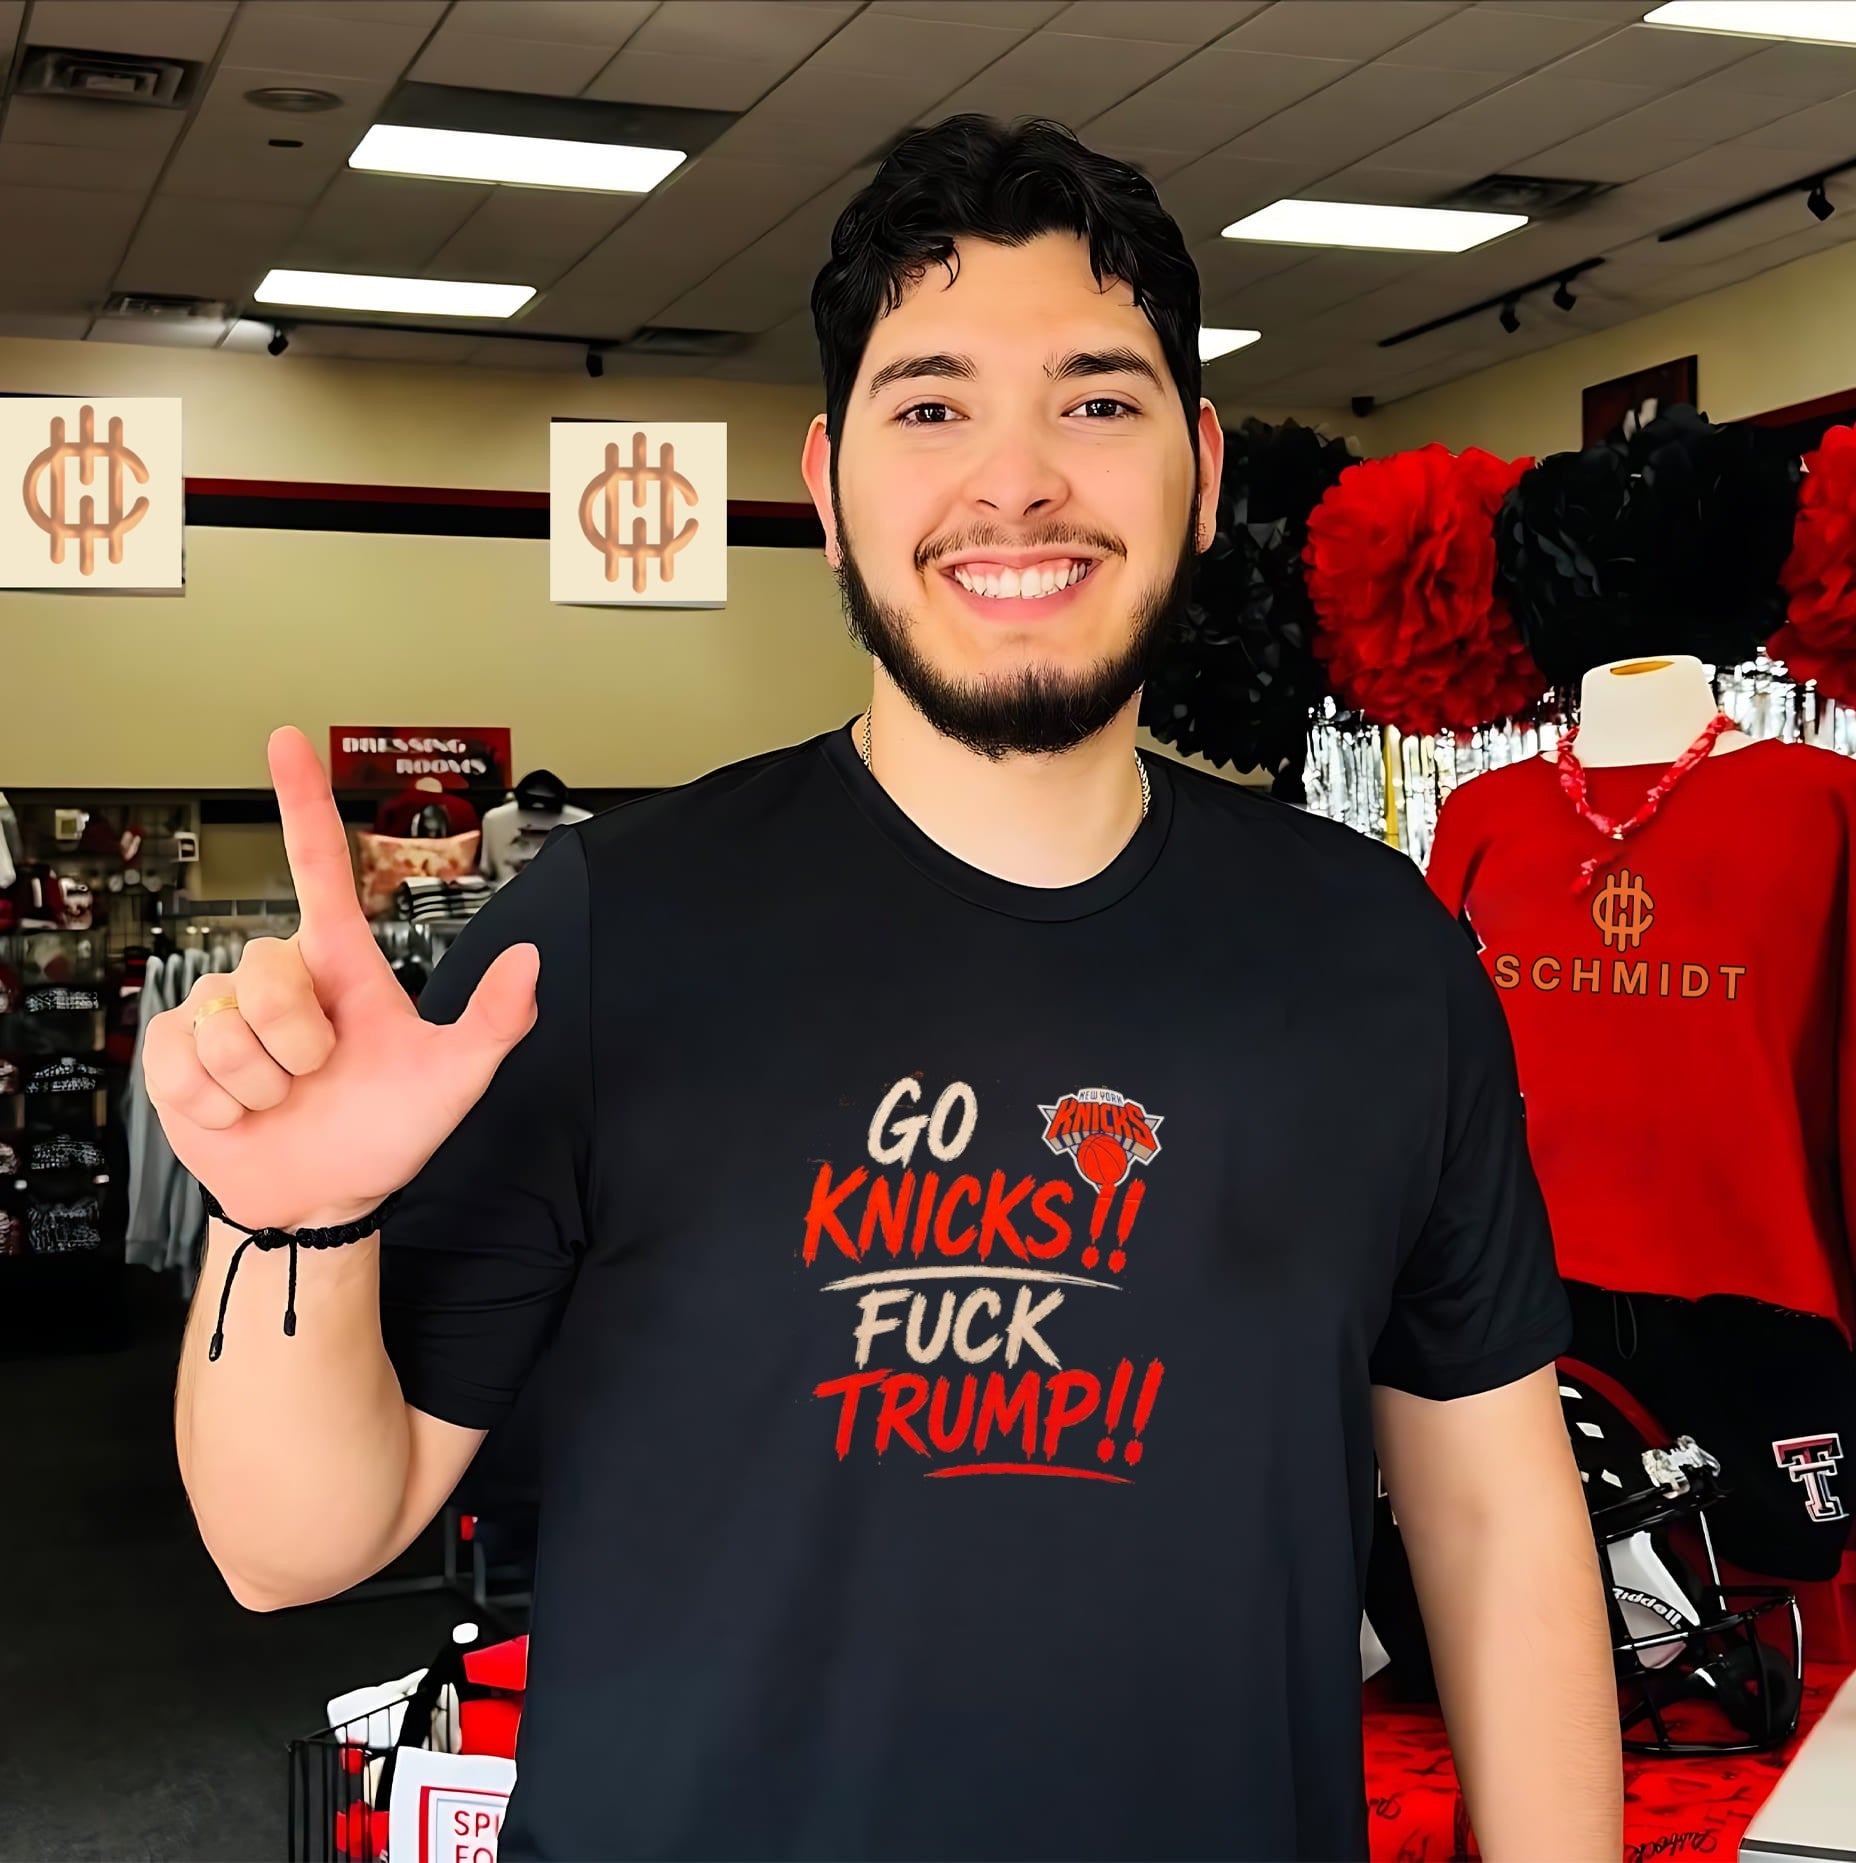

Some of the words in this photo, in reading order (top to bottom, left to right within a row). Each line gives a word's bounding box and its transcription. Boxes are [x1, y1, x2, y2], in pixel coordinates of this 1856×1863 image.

[341, 736, 467, 754] DRESSING
[395, 758, 487, 775] ROOMS
[1493, 953, 1747, 1001] SCHMIDT
[867, 1076, 979, 1168] GO
[1079, 1089, 1098, 1101] NEW
[1099, 1090, 1124, 1105] YORK
[1046, 1098, 1158, 1153] KNICKS
[802, 1161, 1147, 1274] KNICKS!!
[853, 1284, 1066, 1370] FUCK
[811, 1356, 1166, 1467] TRUMP!!
